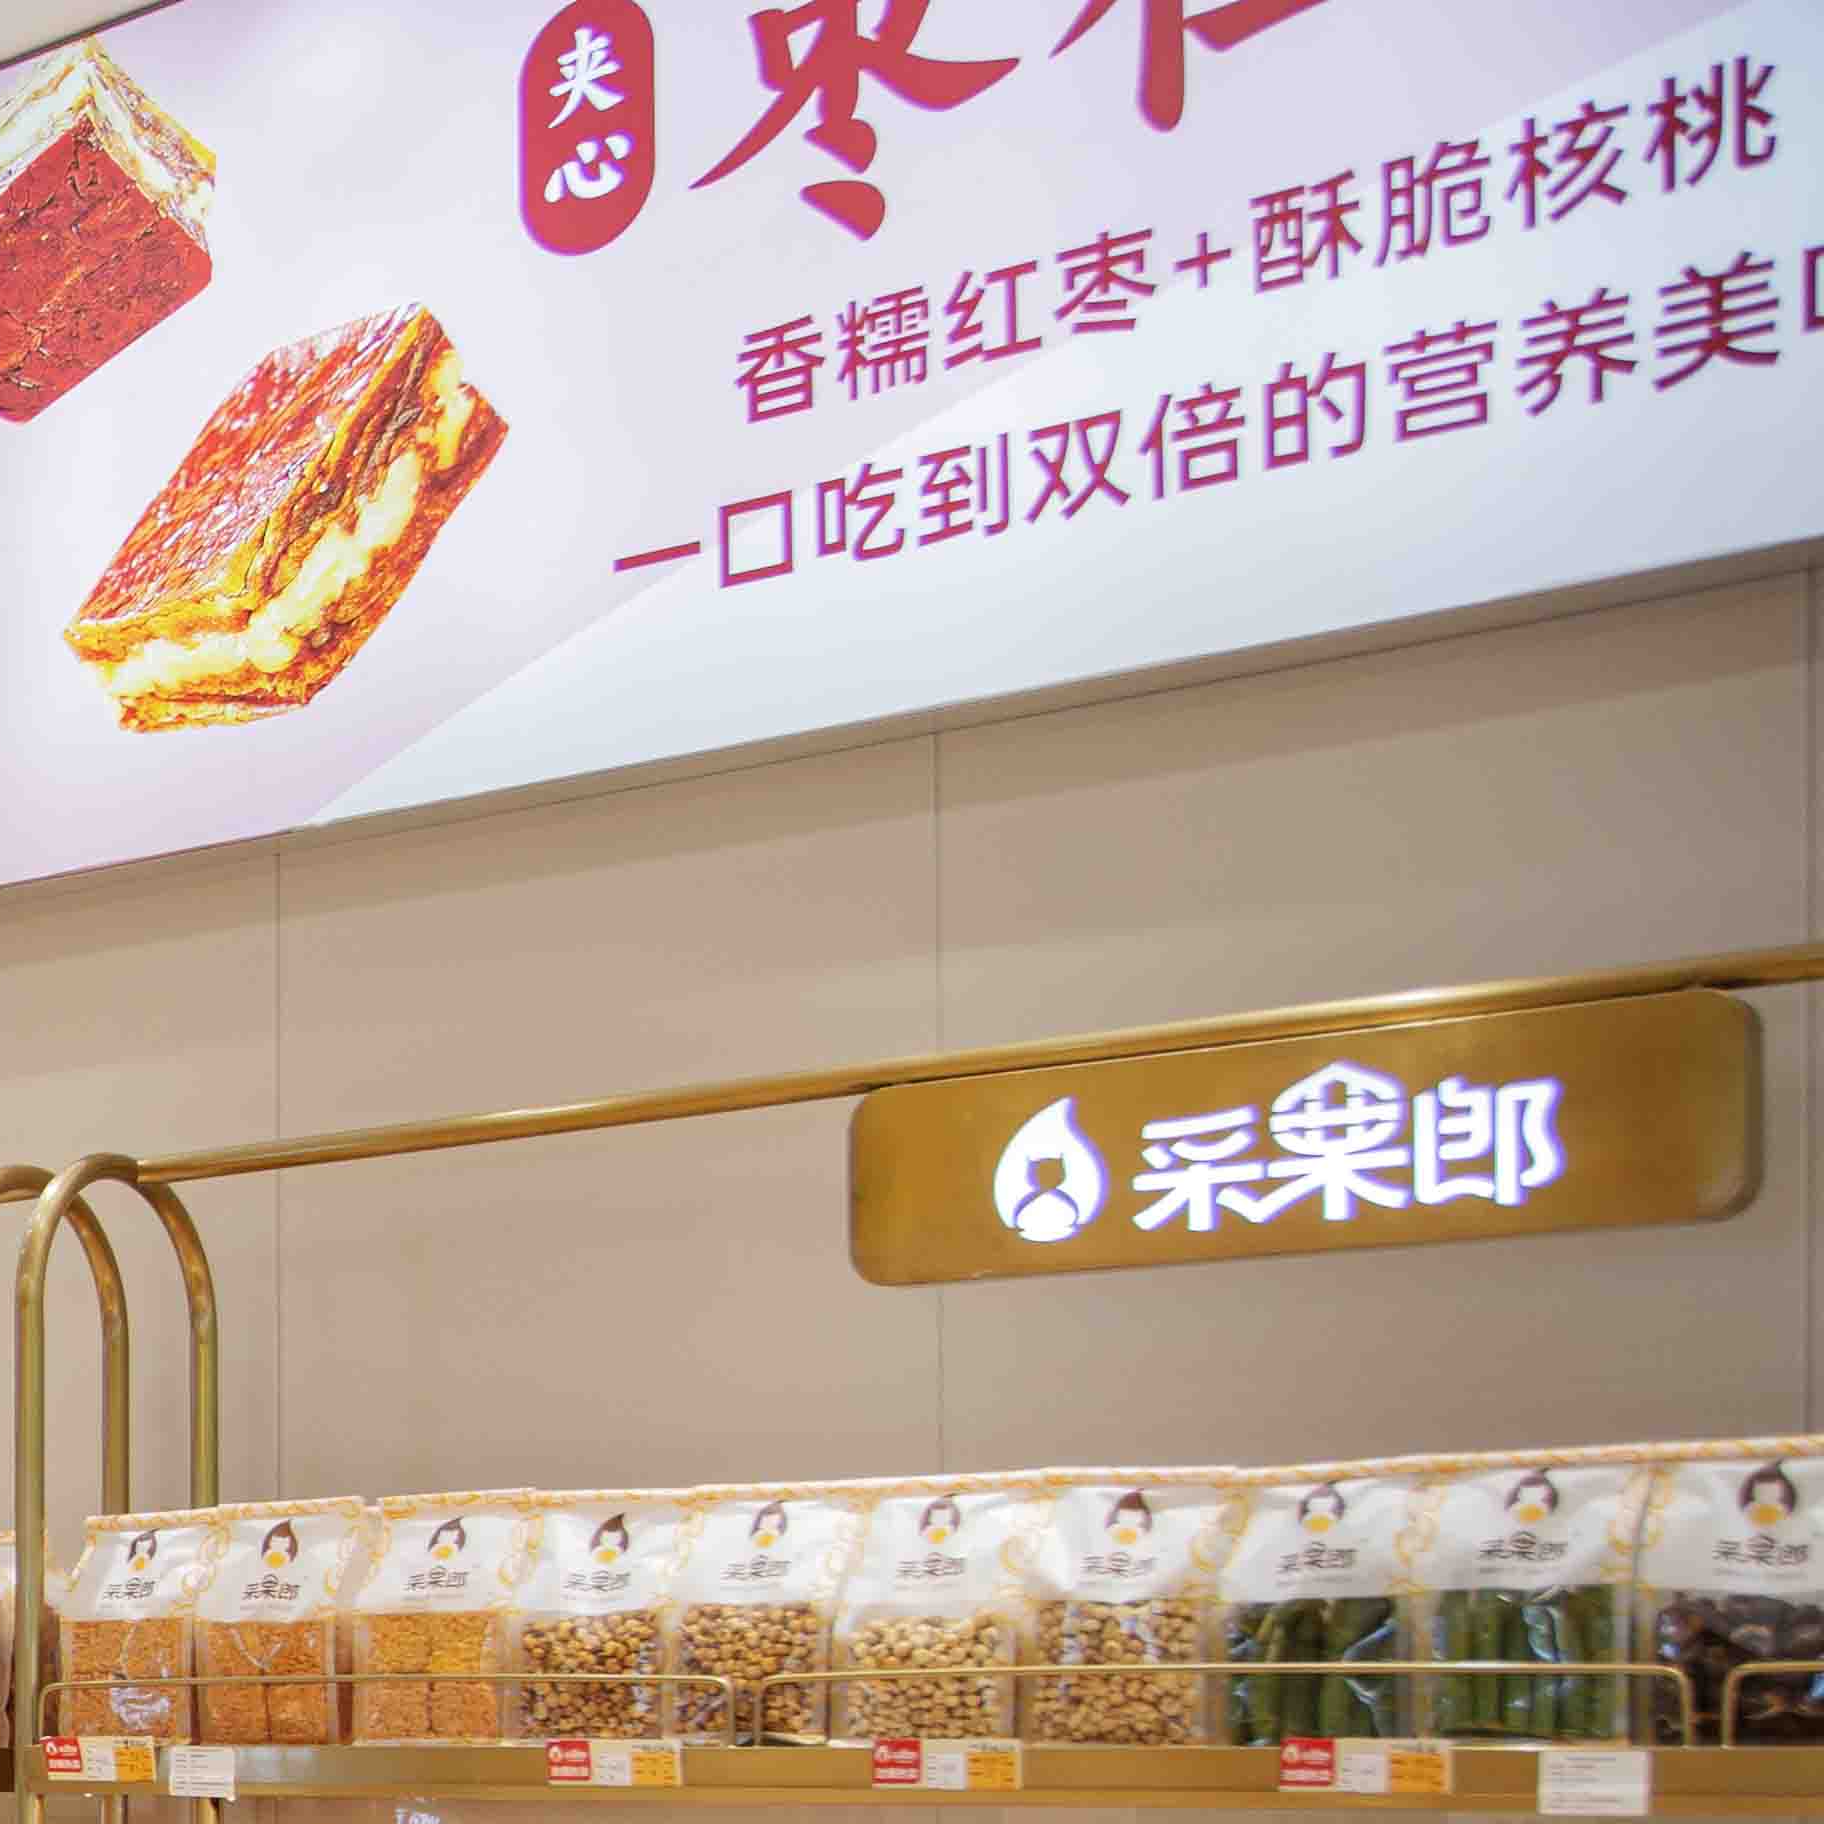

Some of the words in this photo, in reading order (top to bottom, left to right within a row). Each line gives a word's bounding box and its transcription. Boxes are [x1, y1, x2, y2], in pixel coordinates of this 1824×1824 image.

[542, 26, 634, 206] 夹心
[730, 55, 1782, 426] 香糯红枣+酥脆核桃
[1132, 1060, 1566, 1234] 采果郎
